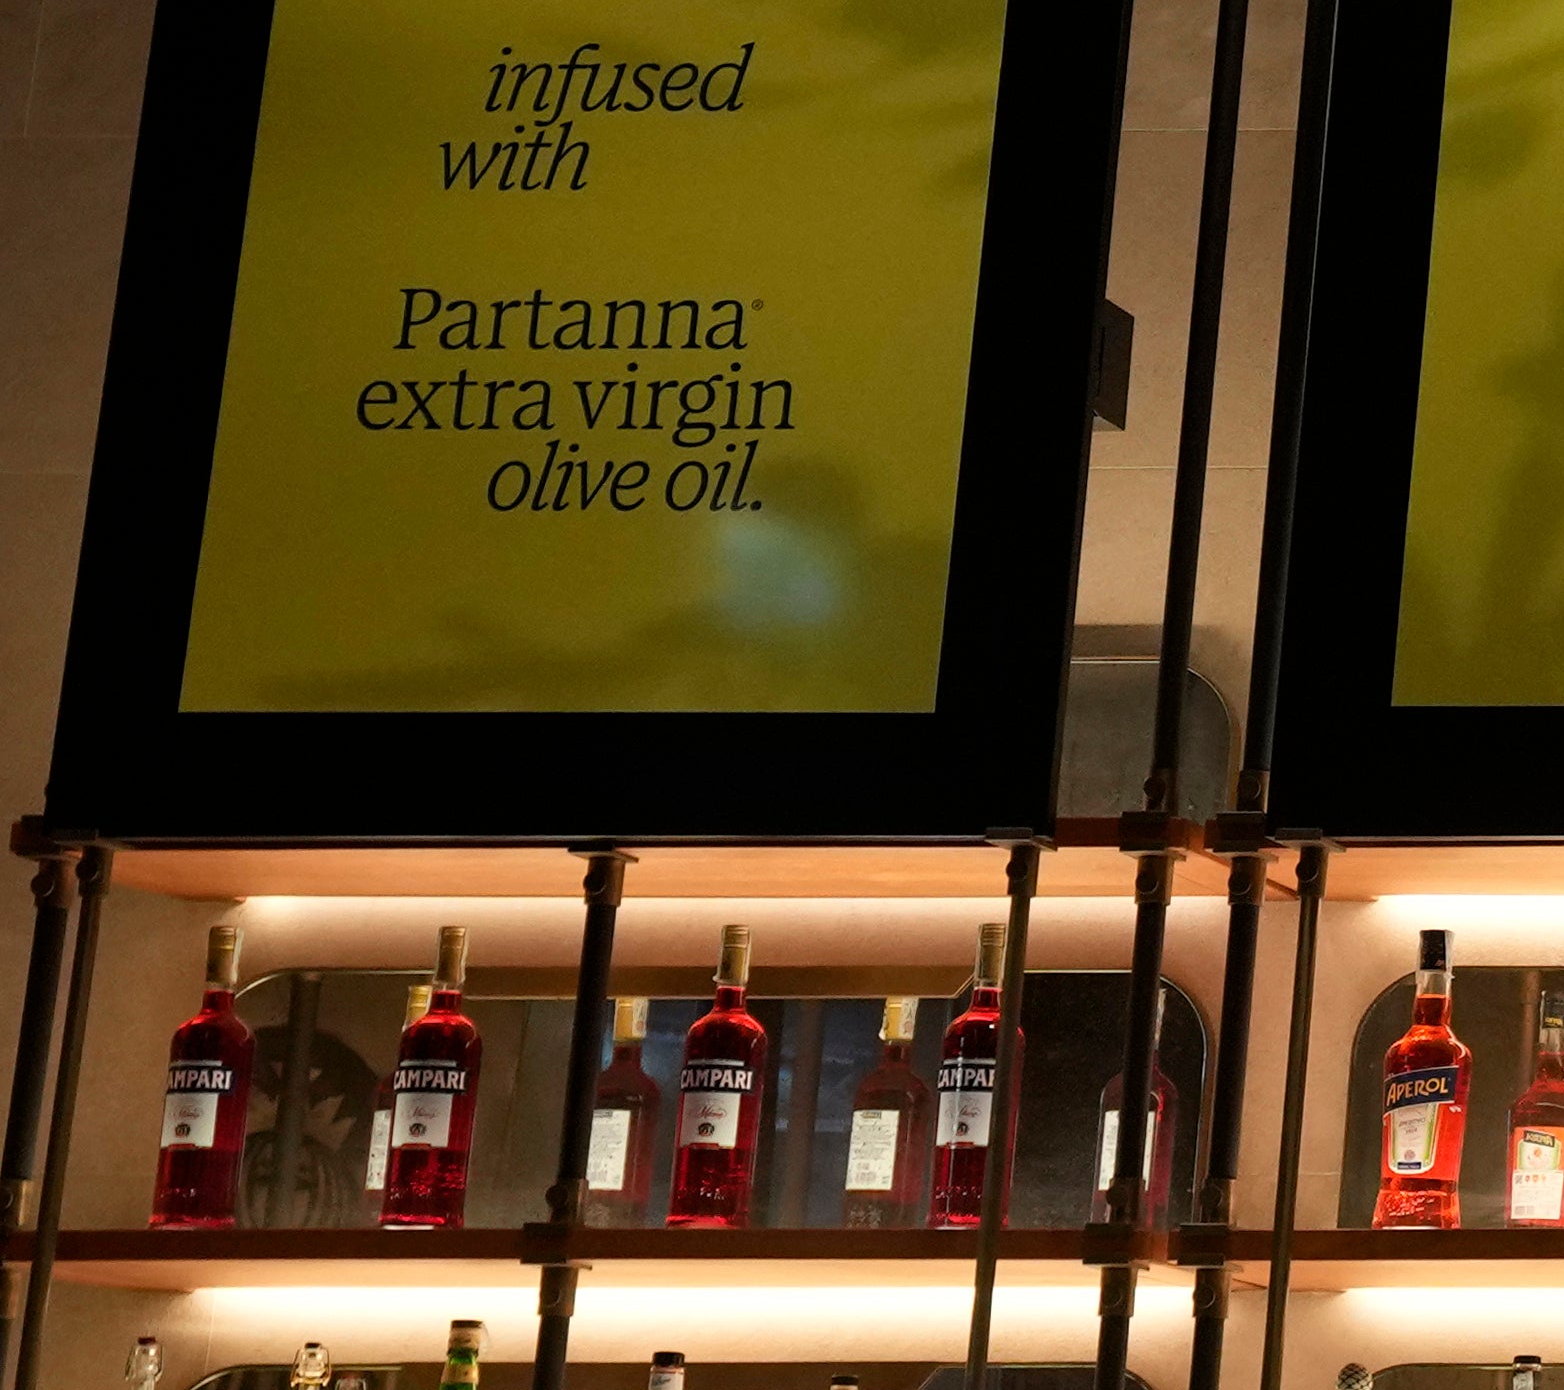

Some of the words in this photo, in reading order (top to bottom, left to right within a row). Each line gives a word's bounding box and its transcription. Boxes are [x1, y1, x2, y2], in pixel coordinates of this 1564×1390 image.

[484, 41, 756, 127] infused
[439, 120, 591, 191] with
[393, 288, 748, 350] Partanna
[356, 368, 554, 431] extra
[573, 361, 795, 448] virgin
[487, 439, 651, 512] olive
[665, 439, 763, 512] oil.
[679, 1066, 753, 1092] CAMPARI
[936, 1067, 996, 1089] CAMPA
[1386, 1076, 1449, 1107] APEROL
